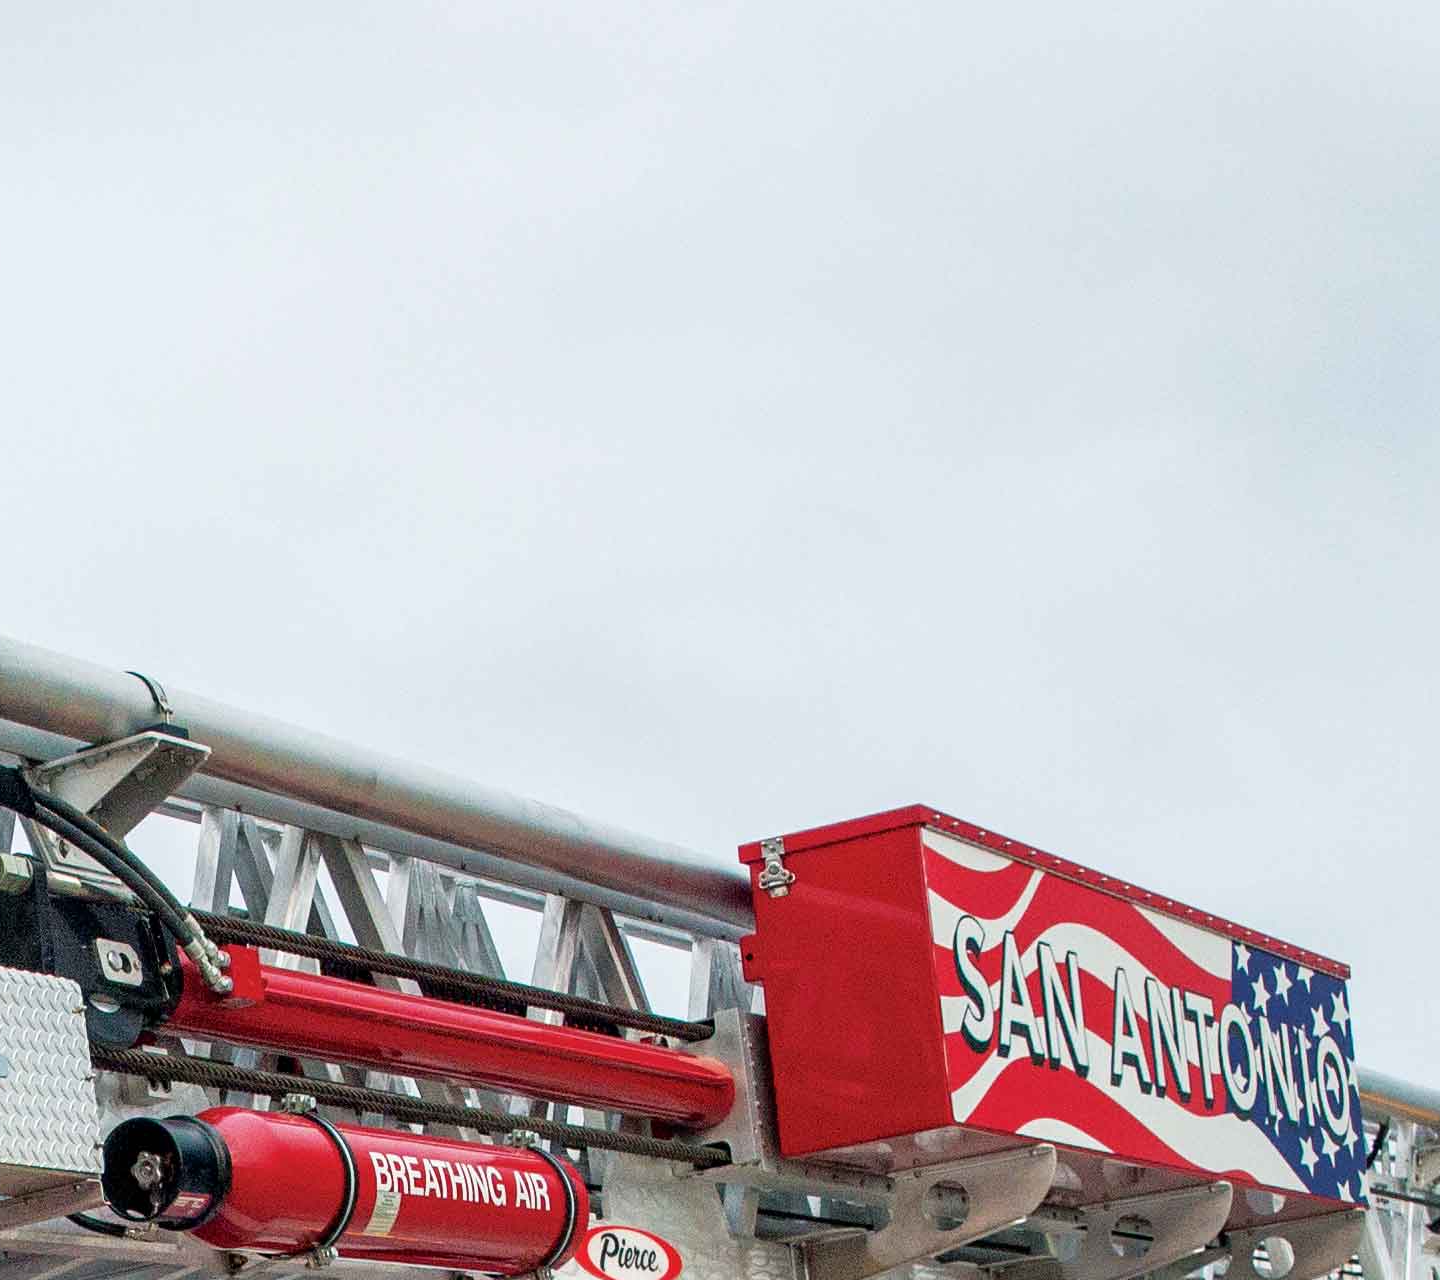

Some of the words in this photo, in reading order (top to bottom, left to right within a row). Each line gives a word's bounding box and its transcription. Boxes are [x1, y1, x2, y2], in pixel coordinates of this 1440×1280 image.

[953, 915, 1089, 1077] SAN
[1111, 967, 1351, 1140] ANTONIO
[369, 1151, 507, 1207] BREATHING
[515, 1169, 551, 1211] AIR
[599, 1232, 659, 1273] Pierce
